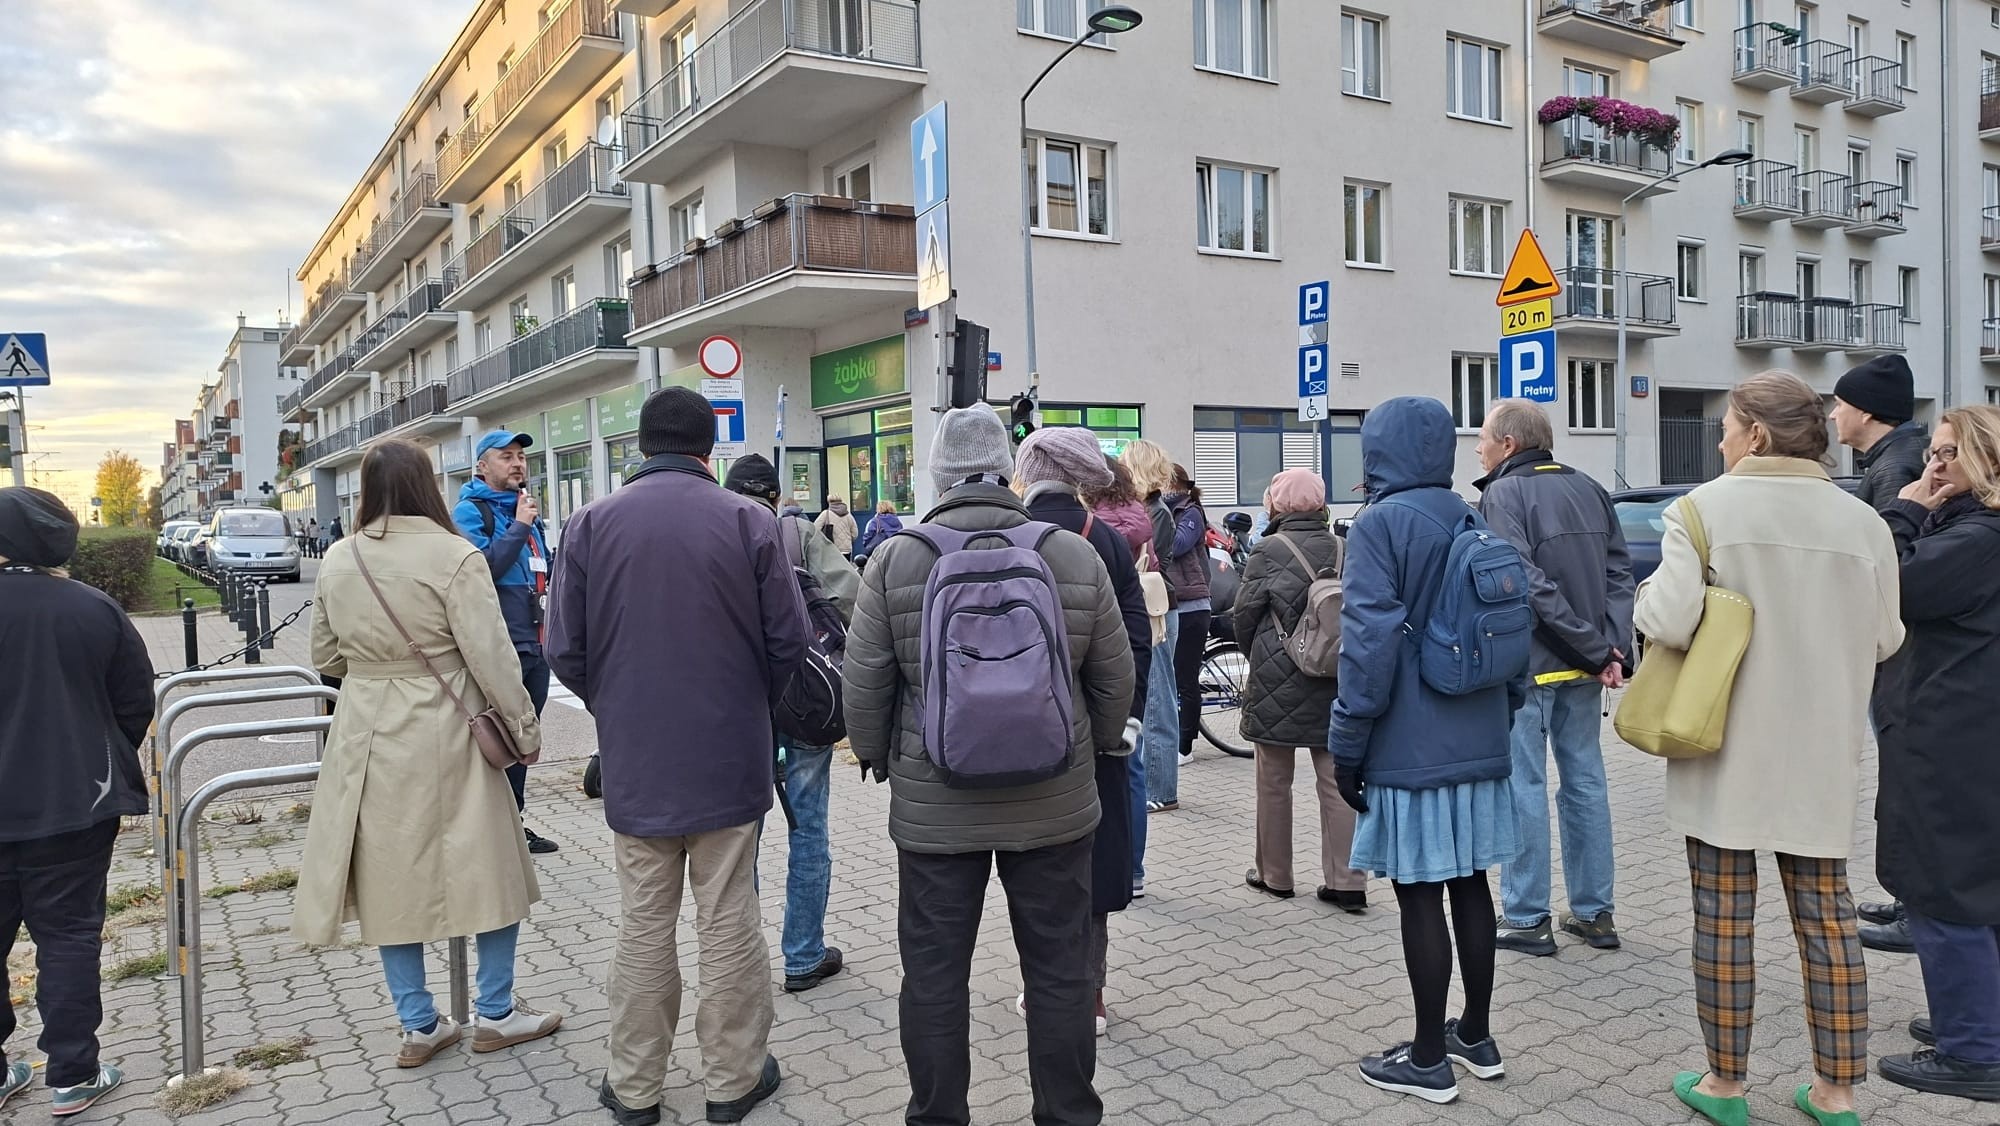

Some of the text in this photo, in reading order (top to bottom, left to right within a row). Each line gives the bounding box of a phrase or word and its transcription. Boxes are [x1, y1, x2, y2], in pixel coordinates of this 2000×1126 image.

[1305, 287, 1323, 320] P
[1508, 310, 1546, 329] 20 m
[834, 356, 876, 385] żabka
[1305, 349, 1322, 383] P
[1511, 340, 1544, 398] P
[1523, 384, 1554, 398] Płatny
